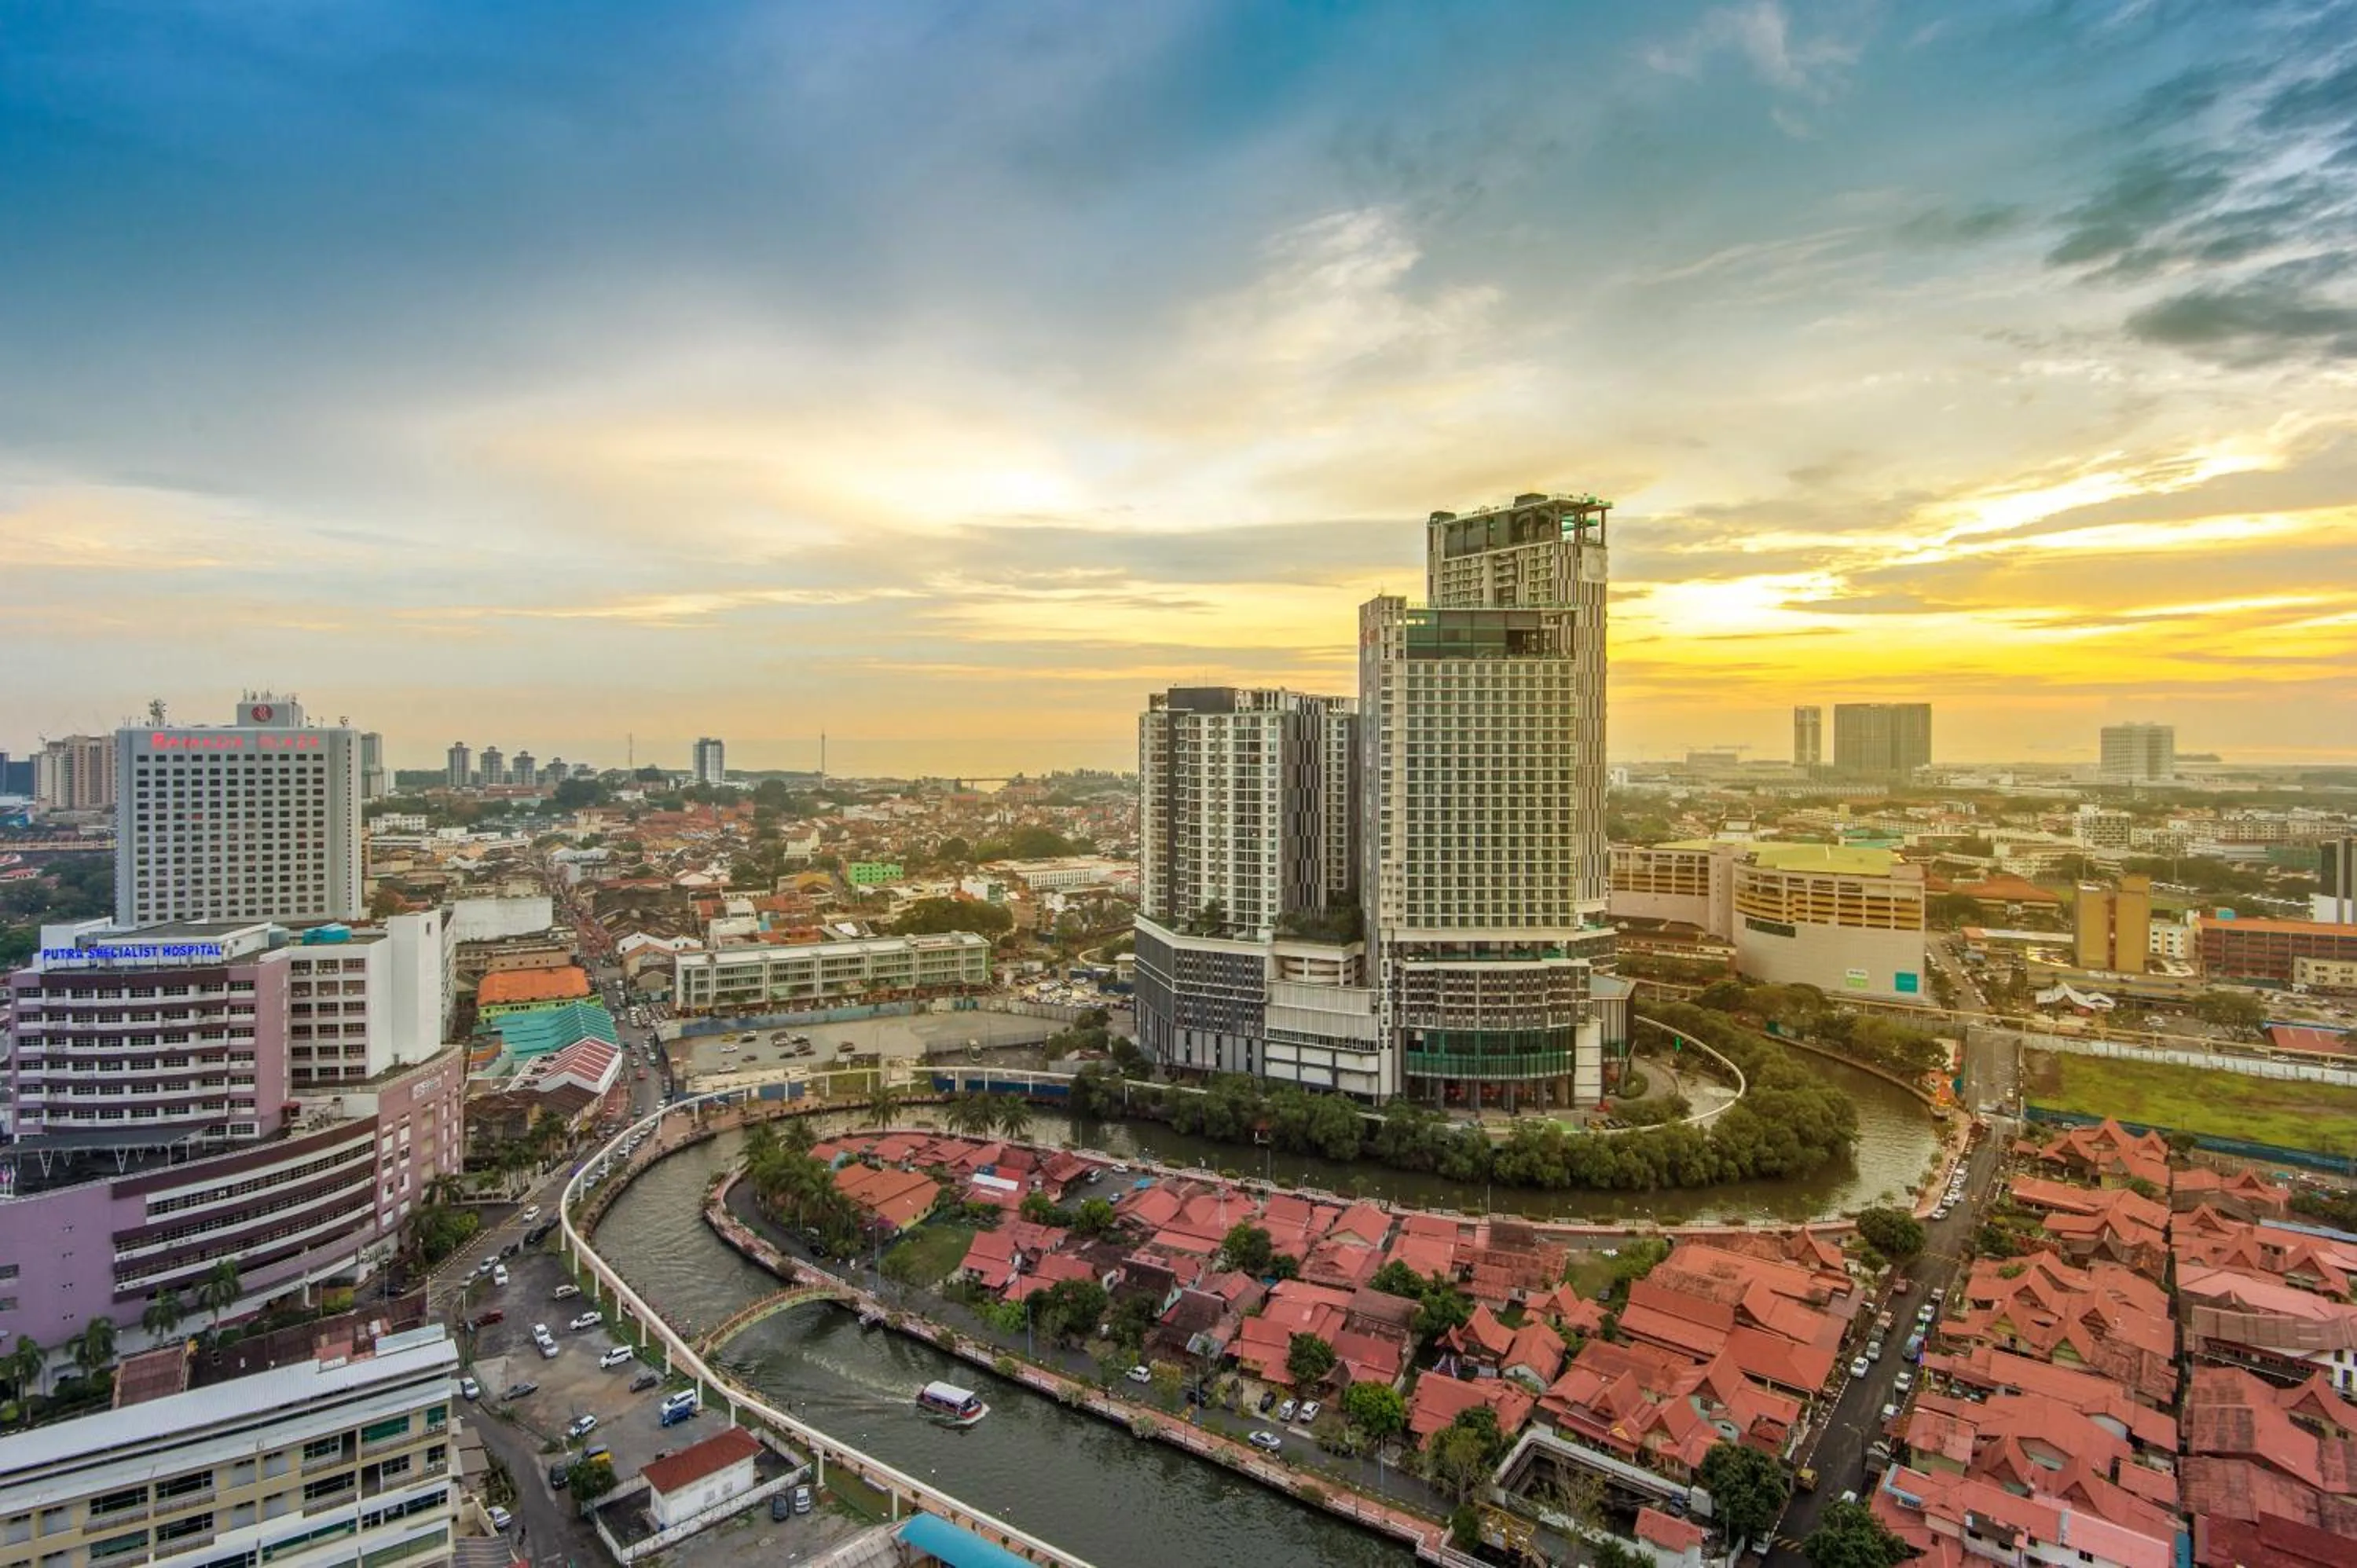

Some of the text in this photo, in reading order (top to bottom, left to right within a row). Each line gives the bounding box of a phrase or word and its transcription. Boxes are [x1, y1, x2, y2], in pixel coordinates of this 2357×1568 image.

[42, 943, 221, 960] PUTRA SPECIALIST HOSPITAL
